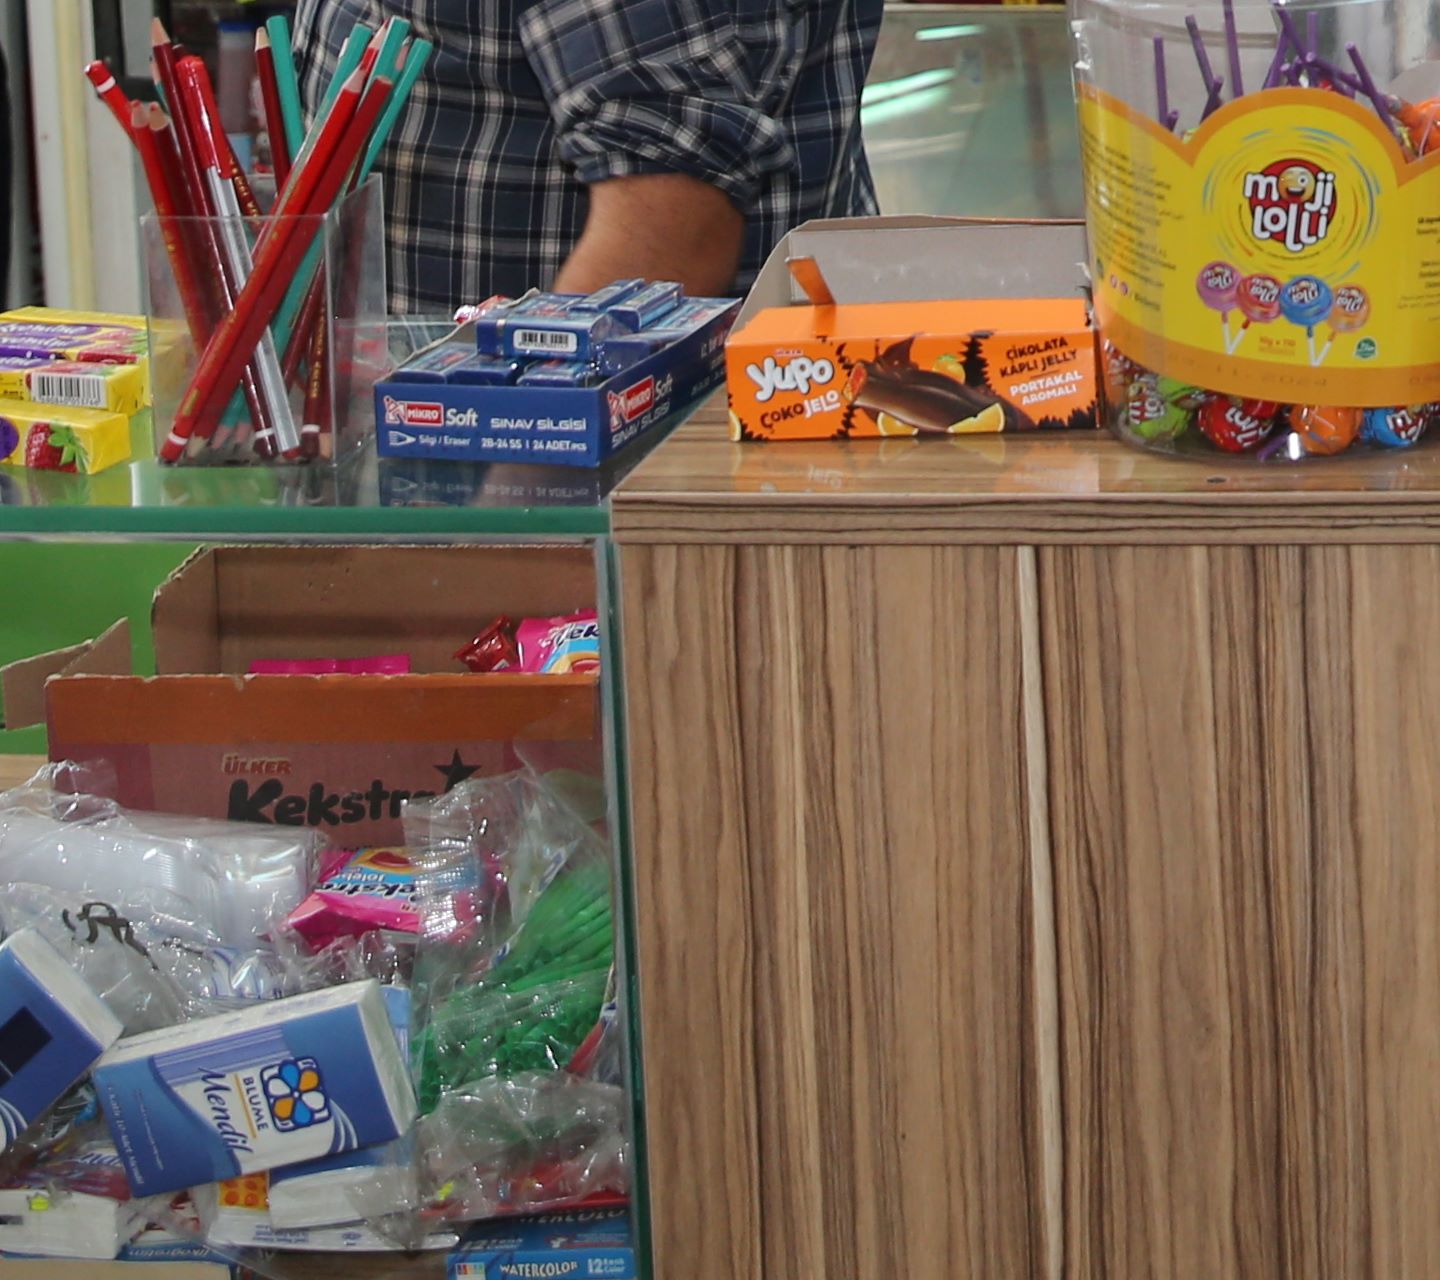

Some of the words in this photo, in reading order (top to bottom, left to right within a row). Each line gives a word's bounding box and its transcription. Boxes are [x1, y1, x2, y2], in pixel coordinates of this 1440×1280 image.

[1005, 335, 1068, 362] ÇİKOLATA
[999, 356, 1040, 379] KAPLI
[1040, 349, 1078, 373] JELLY
[1009, 369, 1083, 397] PORTAKAL
[1021, 384, 1078, 406] AROMALI
[445, 407, 479, 428] Soft
[490, 417, 536, 431] SINAV
[532, 439, 545, 451] 24
[221, 753, 293, 775] ÜLKER
[194, 1064, 257, 1158] Mendil
[239, 1076, 269, 1132] BLUME
[498, 1260, 579, 1279] WATERCOLOR
